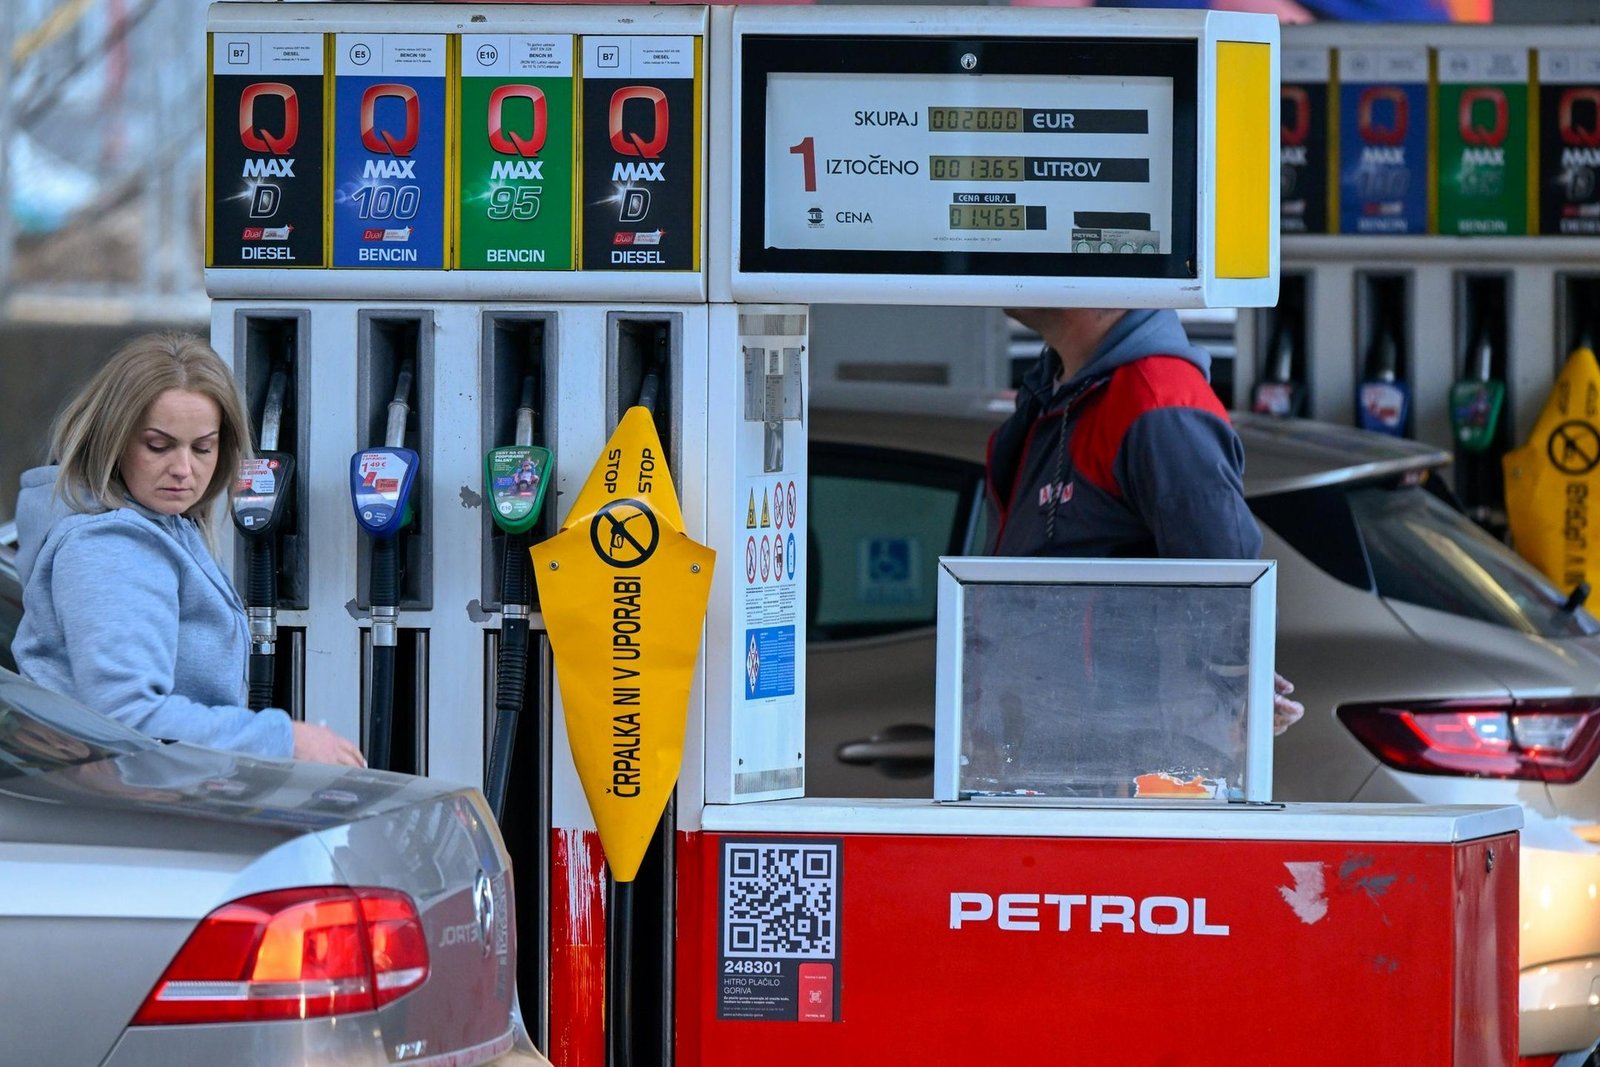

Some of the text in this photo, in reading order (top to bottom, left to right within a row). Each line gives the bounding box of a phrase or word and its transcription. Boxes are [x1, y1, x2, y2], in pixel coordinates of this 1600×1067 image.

[233, 50, 244, 58] B7
[355, 50, 366, 58] E5
[480, 51, 495, 60] E10
[603, 53, 614, 61] B7
[239, 82, 299, 155] Q
[361, 84, 420, 157] Q
[488, 84, 548, 158] Q
[609, 86, 669, 158] Q
[854, 111, 918, 126] SKUPAJ
[1033, 113, 1074, 129] EUR
[1359, 85, 1409, 146] Q
[1458, 86, 1508, 147] Q
[1558, 86, 1600, 148] Q
[790, 137, 816, 192] 1
[826, 154, 918, 175] IZTOČENO
[1034, 161, 1101, 177] LITROV
[1361, 147, 1405, 165] MAX
[1461, 148, 1504, 166] MAX
[242, 158, 296, 178] MAX
[363, 160, 416, 179] MAX
[491, 161, 544, 180] MAX
[612, 162, 666, 181] MAX
[250, 184, 281, 218] D
[352, 186, 420, 219] 100
[487, 186, 542, 220] 95
[619, 188, 650, 222] D
[958, 194, 1010, 203] CENA EUR/L
[836, 212, 873, 223] CENA
[244, 230, 262, 238] Dual
[365, 230, 382, 239] Dual
[616, 234, 633, 242] Dual
[242, 247, 295, 260] DIESEL
[359, 248, 417, 262] BENCIN
[487, 250, 544, 262] BENCIN
[611, 251, 665, 264] DIESEL
[604, 449, 621, 494] STOP
[638, 448, 655, 494] STOP
[606, 576, 641, 798] ČRPALKA NI V UPORABI
[950, 892, 1229, 936] PETROL
[725, 961, 781, 974] 248301
[724, 978, 780, 986] HITRO PLAČILO
